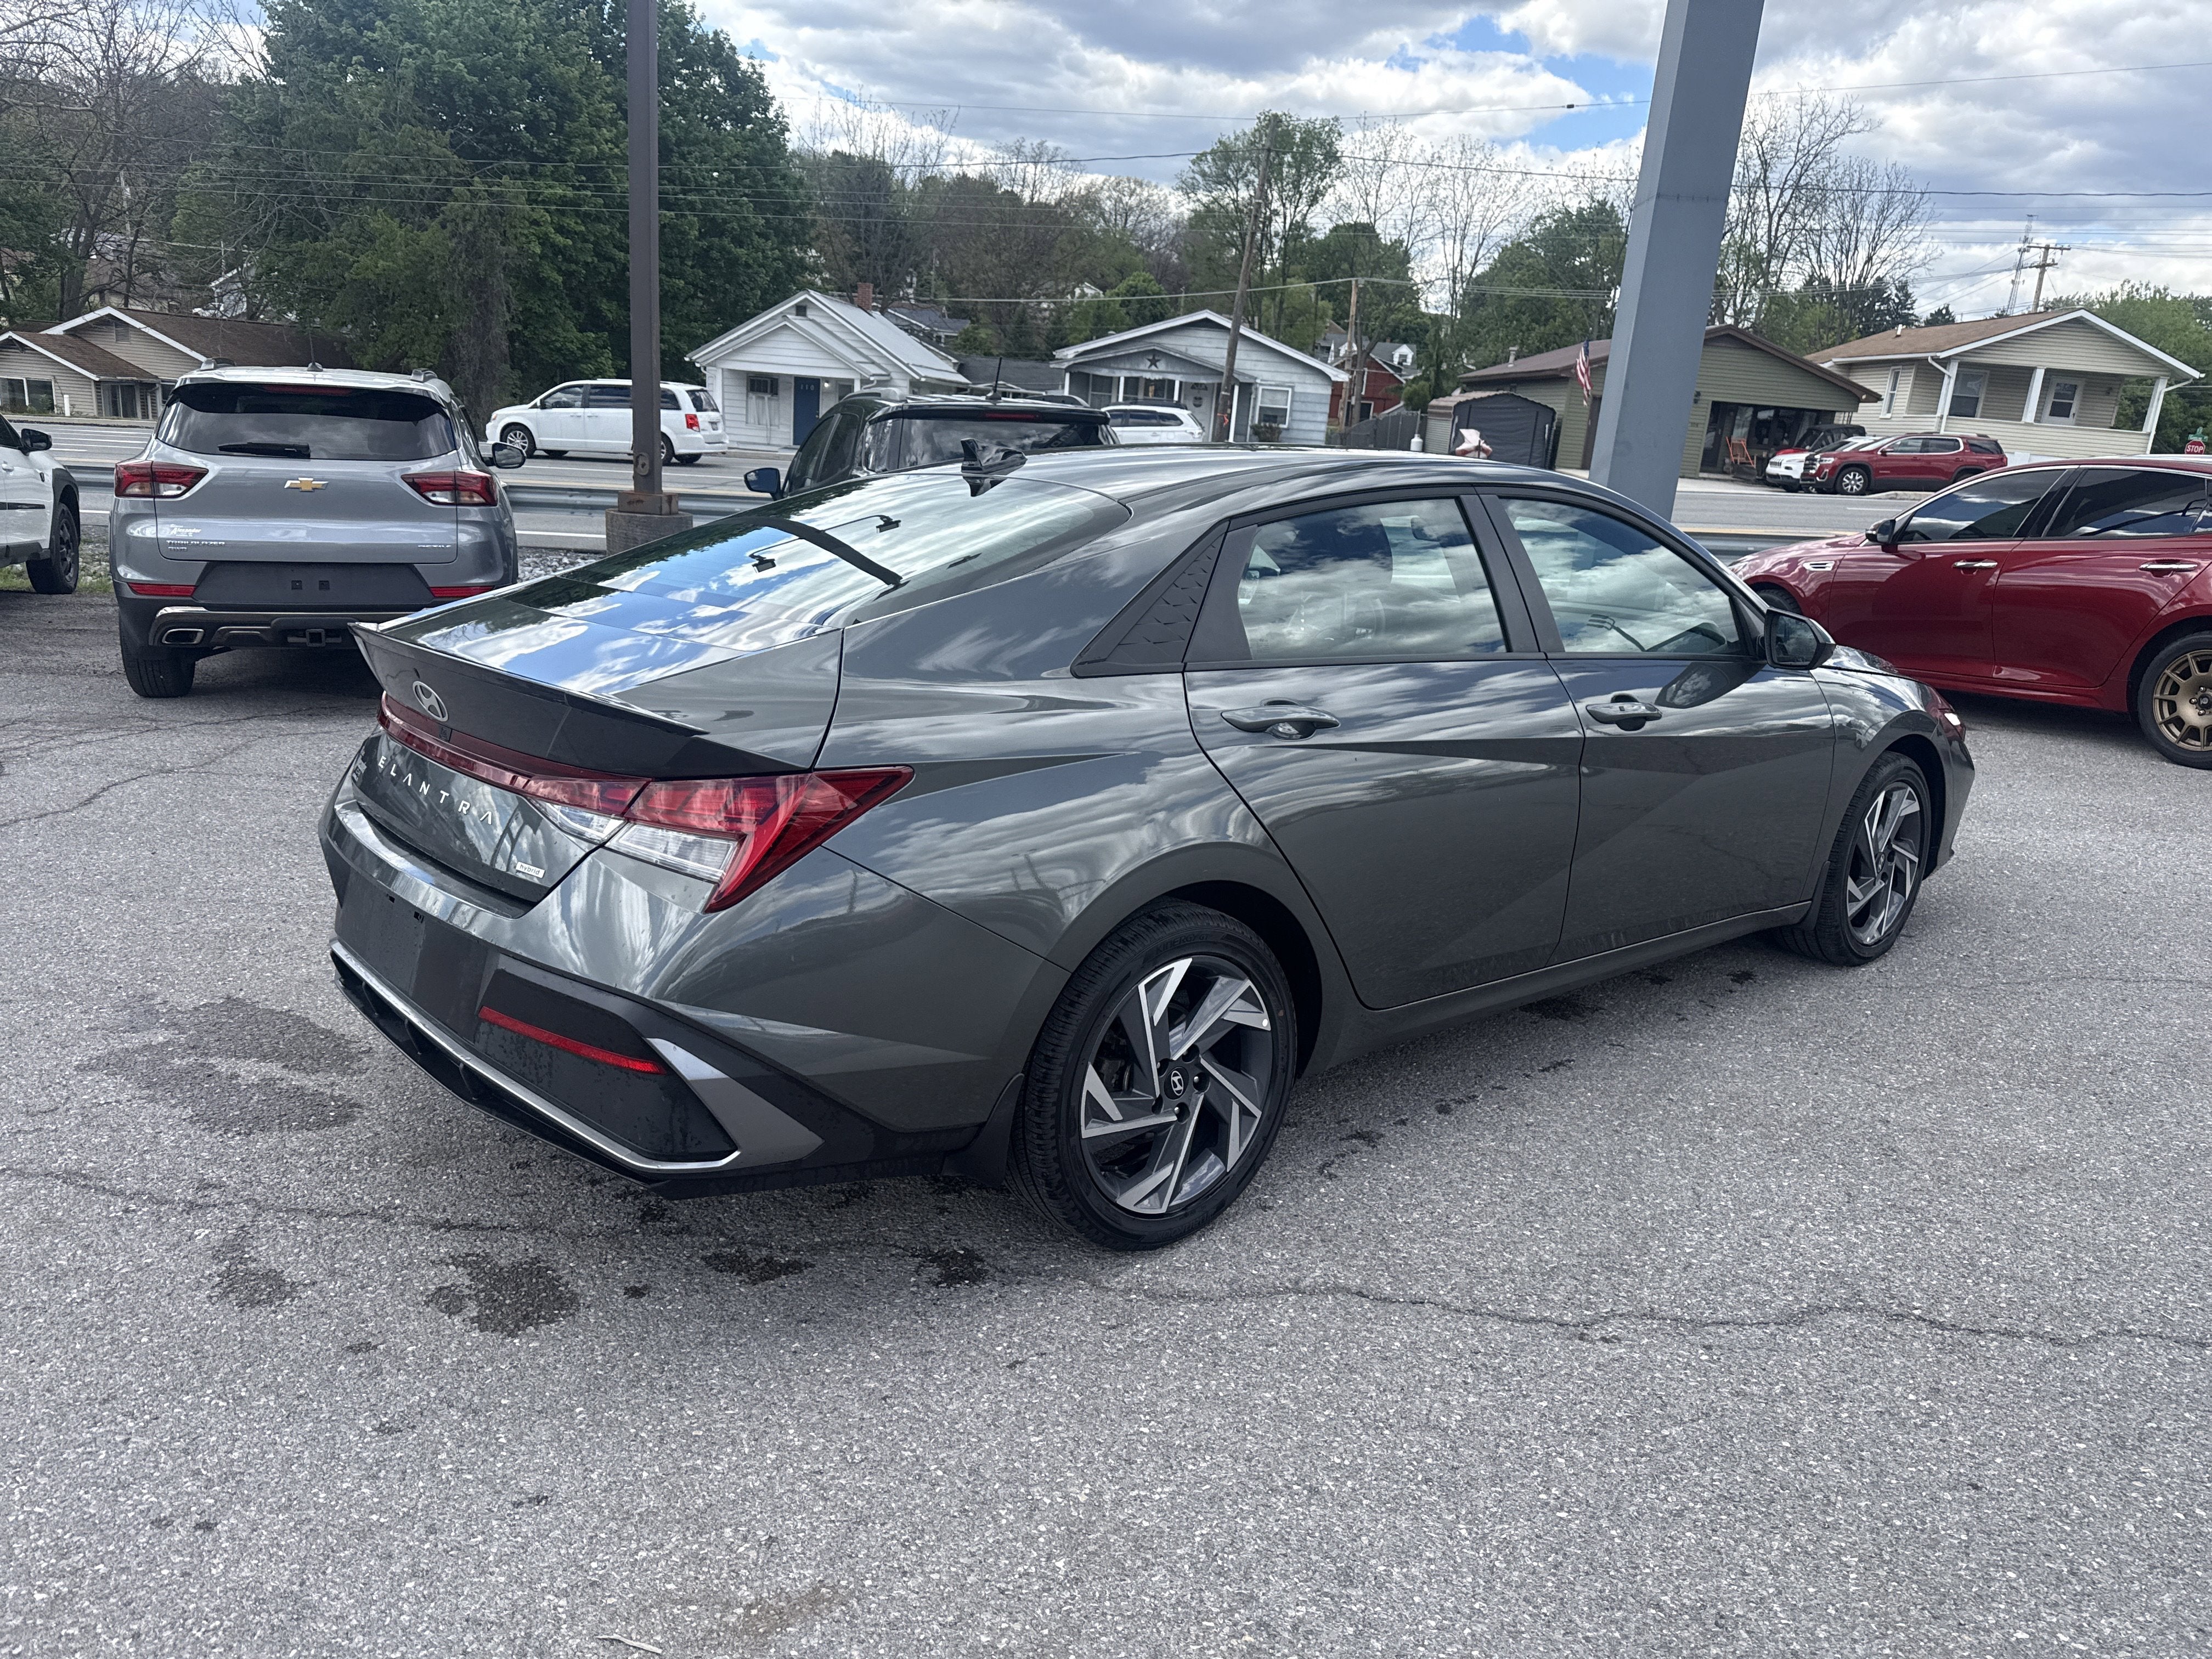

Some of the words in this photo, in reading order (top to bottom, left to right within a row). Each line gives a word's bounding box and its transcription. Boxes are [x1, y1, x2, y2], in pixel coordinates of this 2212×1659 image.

[2186, 445, 2204, 453] STOP
[378, 755, 493, 825] ELANTRA
[519, 864, 540, 875] hybrid
